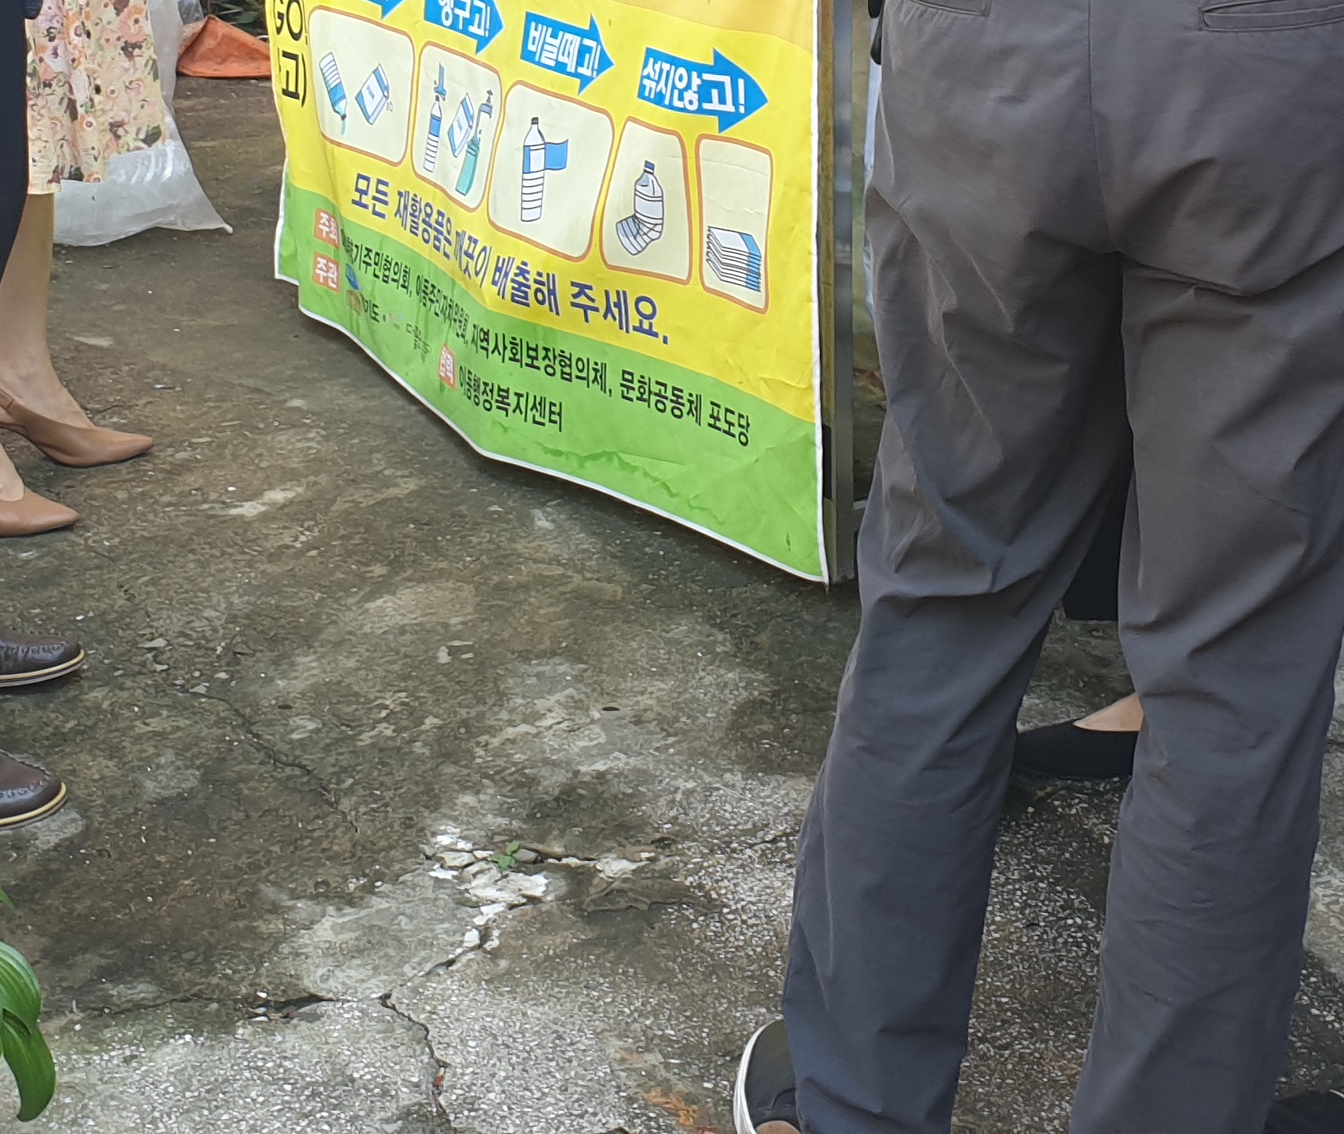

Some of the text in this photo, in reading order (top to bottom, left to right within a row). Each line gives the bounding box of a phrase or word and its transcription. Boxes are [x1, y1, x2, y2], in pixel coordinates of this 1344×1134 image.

[277, 47, 307, 108] 고)
[526, 21, 602, 79] 비닐떼고!
[641, 57, 746, 114] 섞지않고!
[315, 256, 339, 289] 주관
[351, 172, 390, 220] 모든
[393, 189, 453, 261] 재활용품은
[491, 254, 562, 317] 배출해
[569, 279, 669, 345] 주세요.
[458, 365, 564, 433] 이동행정복지센터
[619, 368, 702, 427] 문화공동체
[707, 400, 751, 447] 포도당
